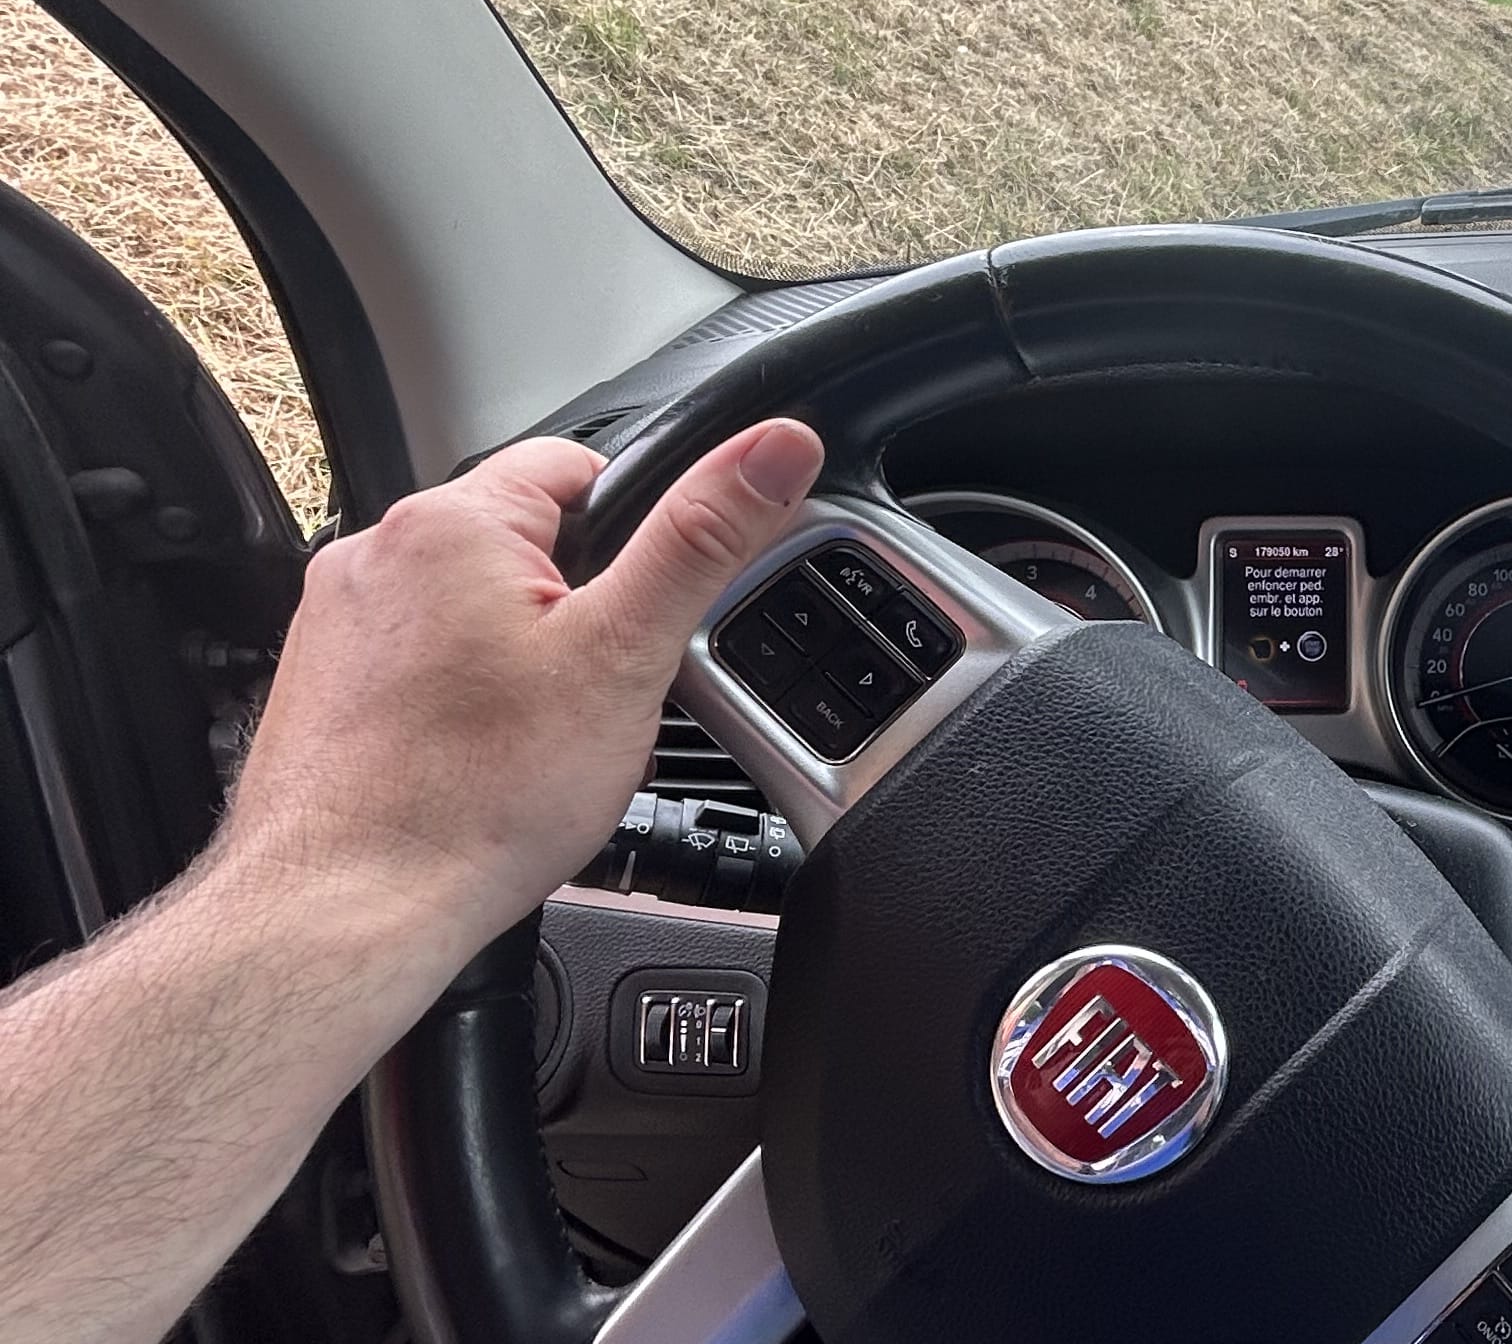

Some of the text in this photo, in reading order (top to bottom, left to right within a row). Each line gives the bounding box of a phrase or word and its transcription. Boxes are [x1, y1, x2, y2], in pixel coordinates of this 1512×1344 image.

[1292, 547, 1309, 557] km
[1027, 565, 1038, 581] 3
[1245, 566, 1271, 578] Pour
[857, 579, 874, 597] VR
[1085, 584, 1097, 600] 4
[1247, 580, 1298, 591] enfoncer
[1468, 583, 1488, 598] 80
[1249, 593, 1324, 606] embr. et app.
[1249, 605, 1323, 617] sur le bouton
[1445, 603, 1466, 618] 60
[1432, 628, 1453, 642] 40
[1427, 659, 1448, 674] 20
[815, 700, 845, 730] BACK
[1031, 993, 1184, 1140] FIAT
